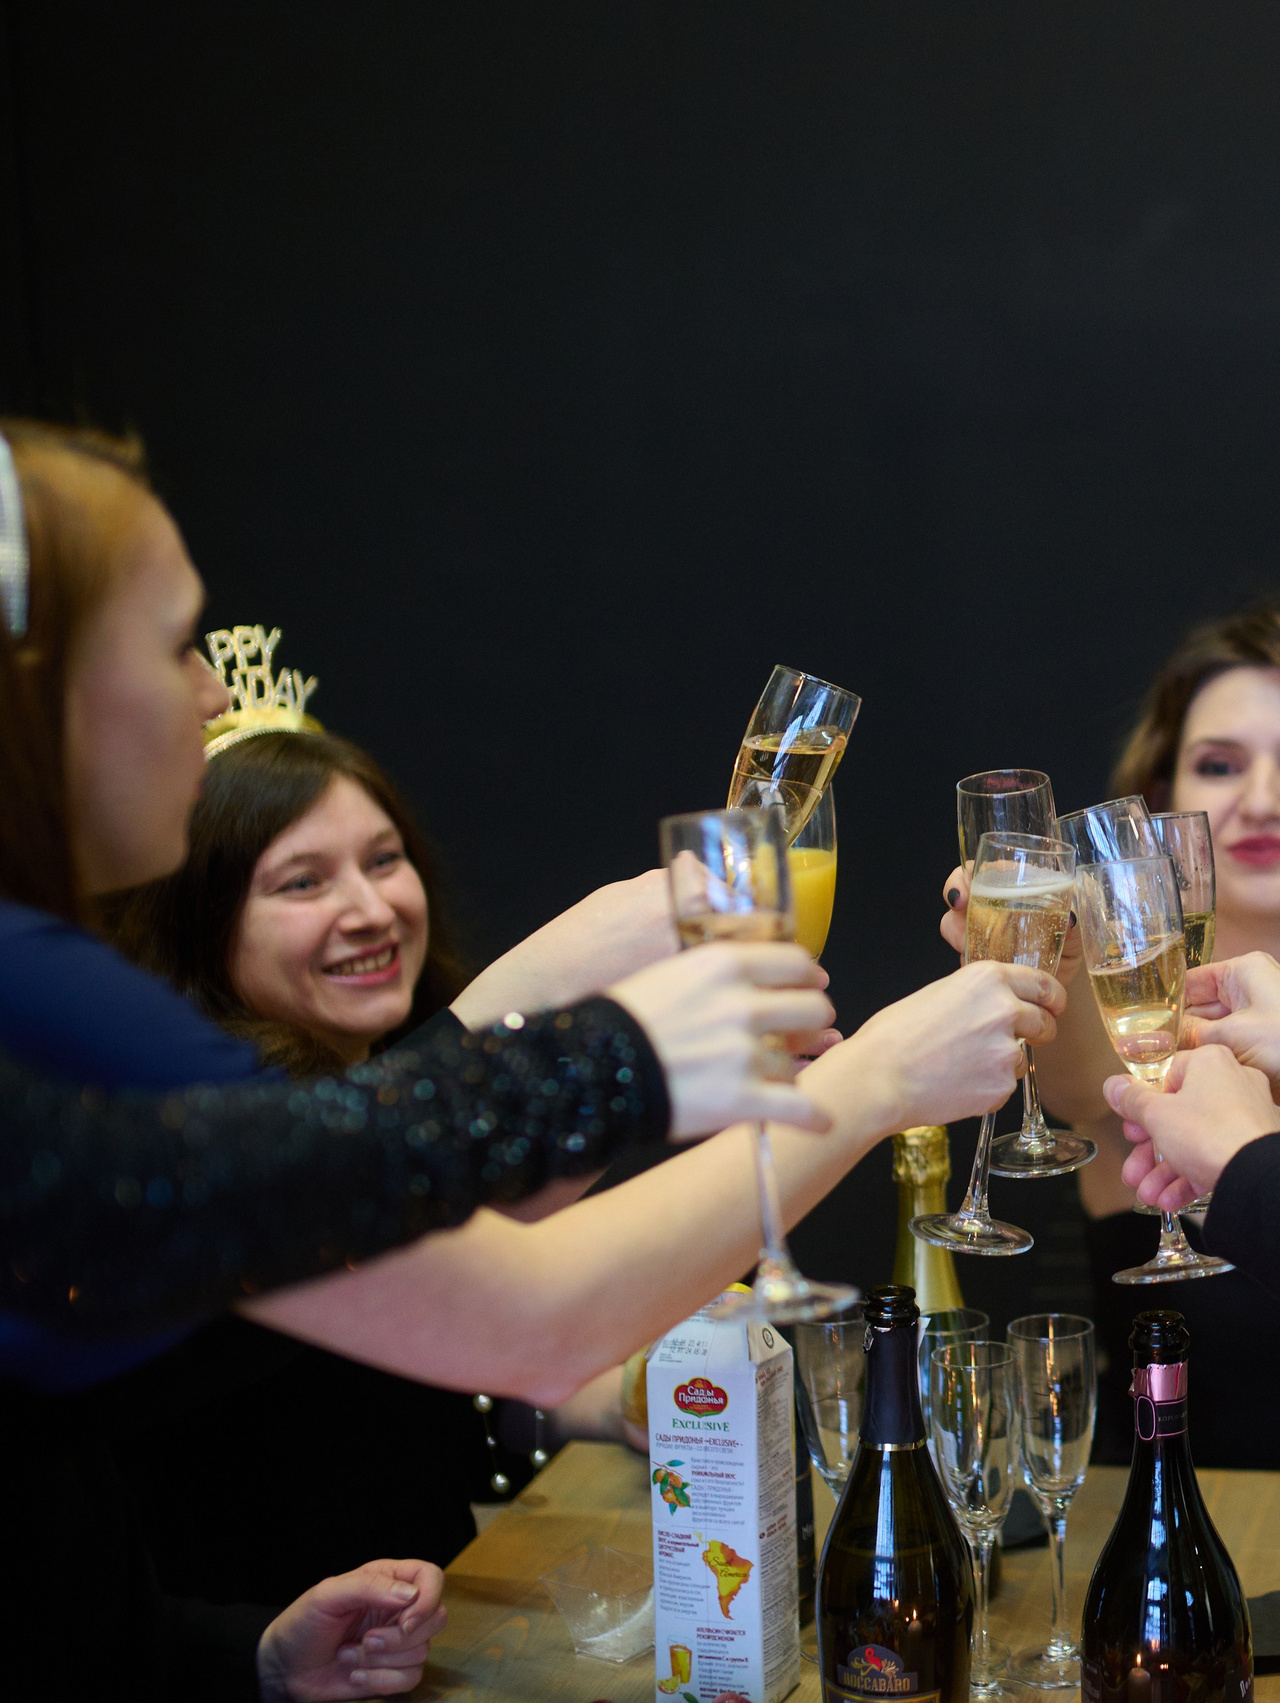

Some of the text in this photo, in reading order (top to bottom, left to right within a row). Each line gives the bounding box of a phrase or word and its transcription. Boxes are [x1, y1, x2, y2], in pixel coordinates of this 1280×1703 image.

[205, 624, 282, 677] PPY
[687, 1385, 714, 1396] Сады
[678, 1392, 724, 1405] Придонья
[672, 1418, 730, 1432] EXCLUSIVE
[655, 1434, 671, 1442] САДЫ
[672, 1435, 703, 1444] ПРИДОНЬЯ
